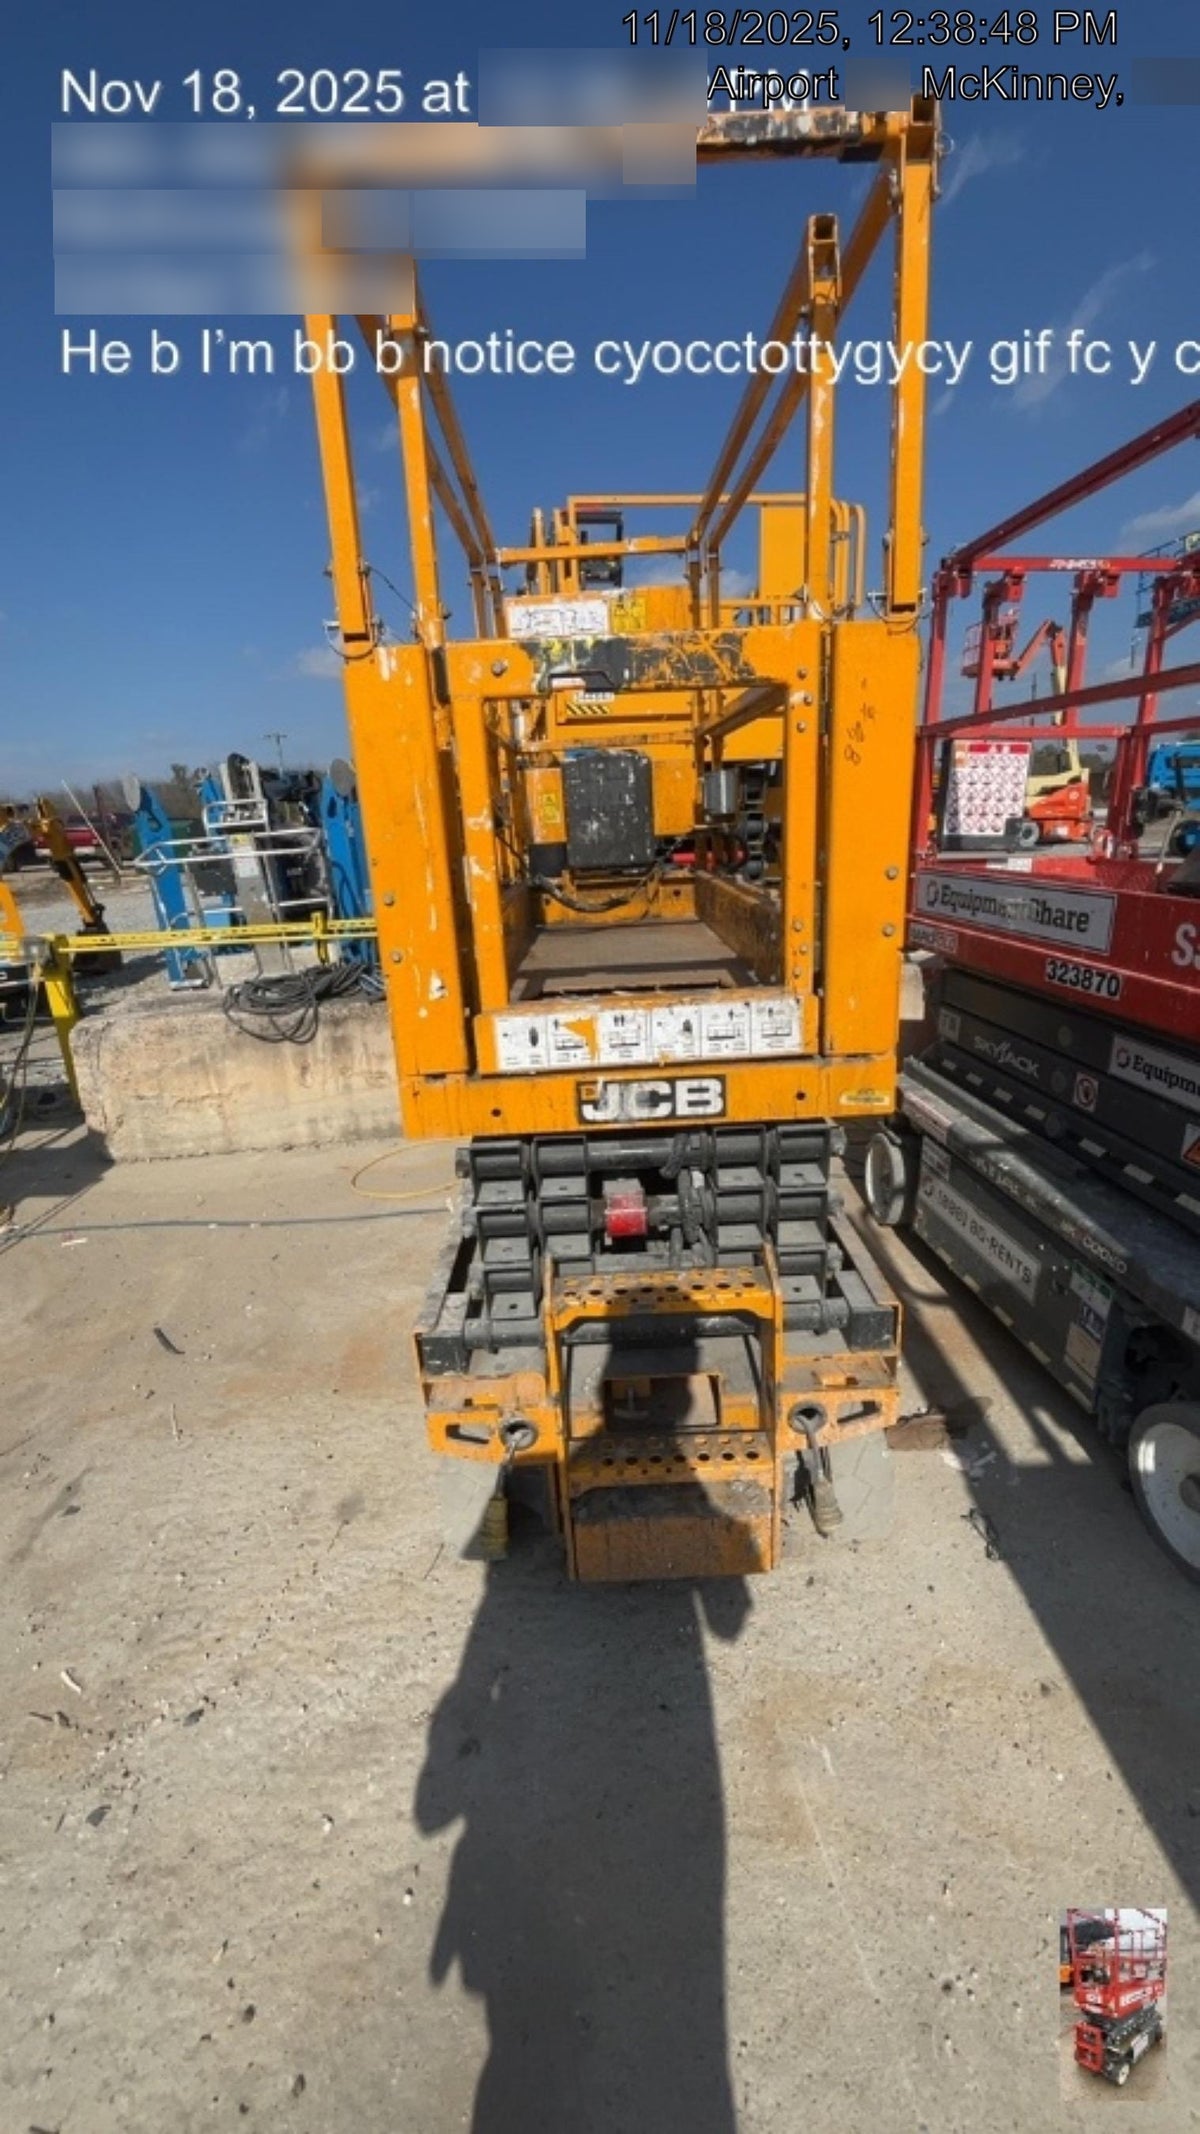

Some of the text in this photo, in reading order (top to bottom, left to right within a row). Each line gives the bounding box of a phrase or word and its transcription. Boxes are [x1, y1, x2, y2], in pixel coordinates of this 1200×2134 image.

[1047, 961, 1120, 997] 323870
[1132, 1054, 1200, 1097] Equipm
[581, 1077, 724, 1122] JCB
